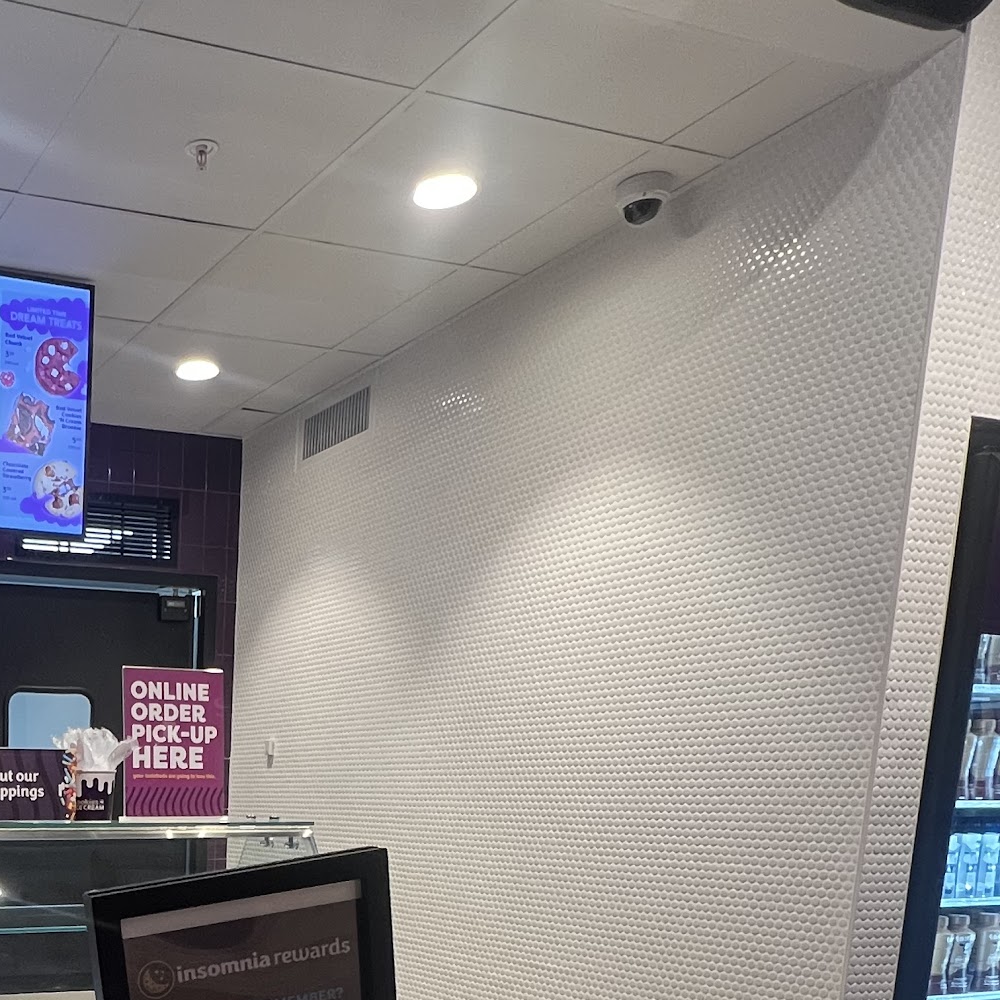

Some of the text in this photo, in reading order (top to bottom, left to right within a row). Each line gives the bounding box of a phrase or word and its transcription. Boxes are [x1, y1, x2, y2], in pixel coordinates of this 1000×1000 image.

[10, 311, 82, 331] DREAM TREATS
[130, 680, 210, 702] ONLINE
[131, 702, 206, 723] ORDER
[132, 723, 218, 744] PICK-UP
[132, 745, 204, 770] HERE
[15, 772, 39, 783] our
[176, 937, 351, 984] insomnia rewards
